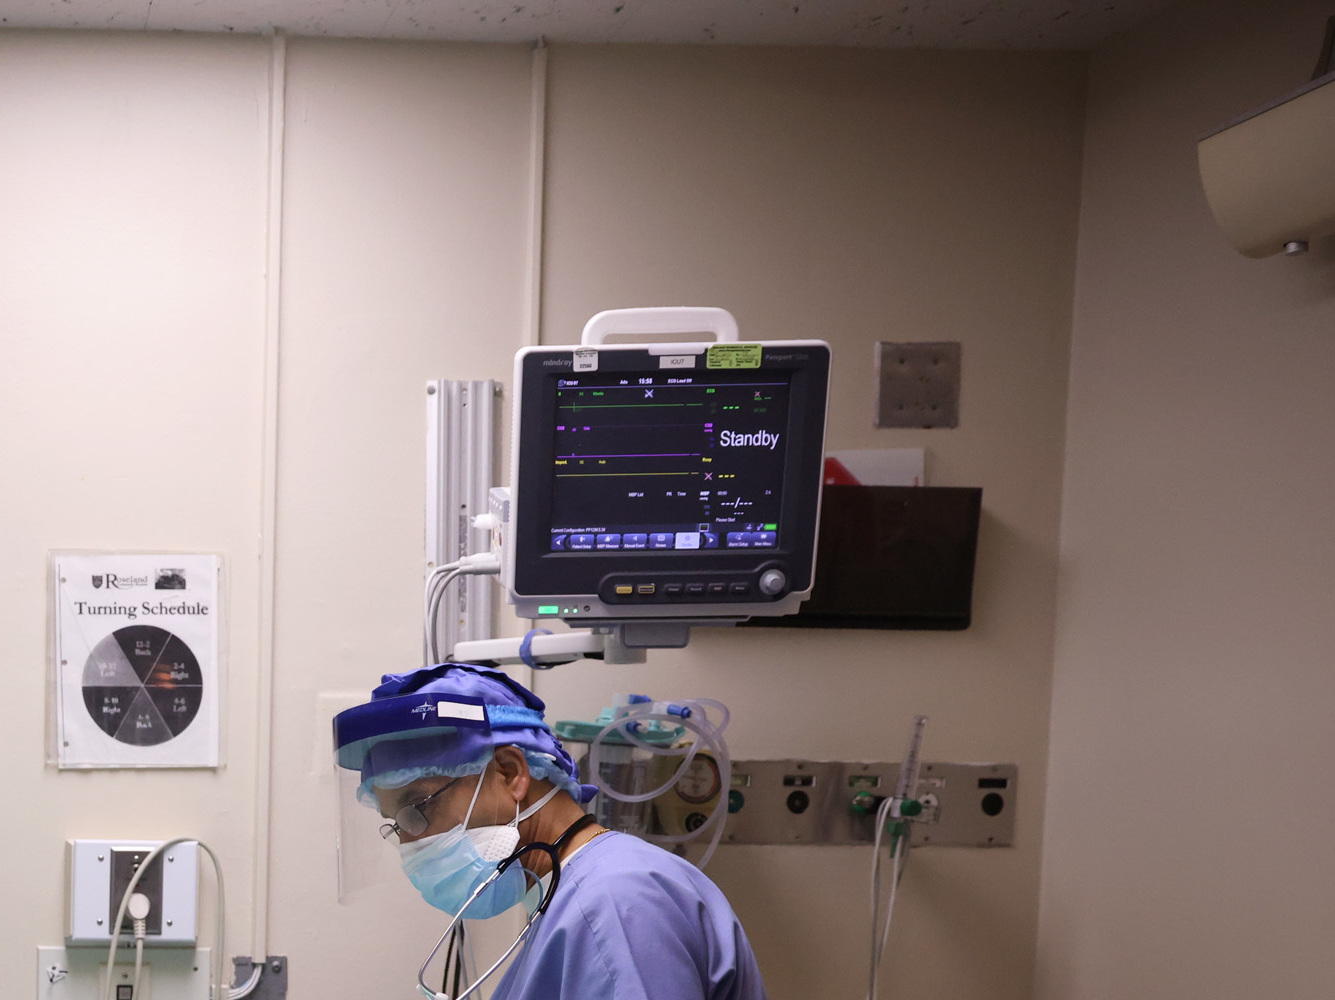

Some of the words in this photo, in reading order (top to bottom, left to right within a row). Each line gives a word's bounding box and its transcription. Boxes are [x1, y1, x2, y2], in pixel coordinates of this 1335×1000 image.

[543, 359, 573, 368] mindray
[719, 430, 779, 450] Standby
[105, 573, 148, 589] Roseland
[74, 601, 138, 619] Turning
[141, 601, 209, 616] Schedule
[411, 706, 437, 714] MEDLINE
